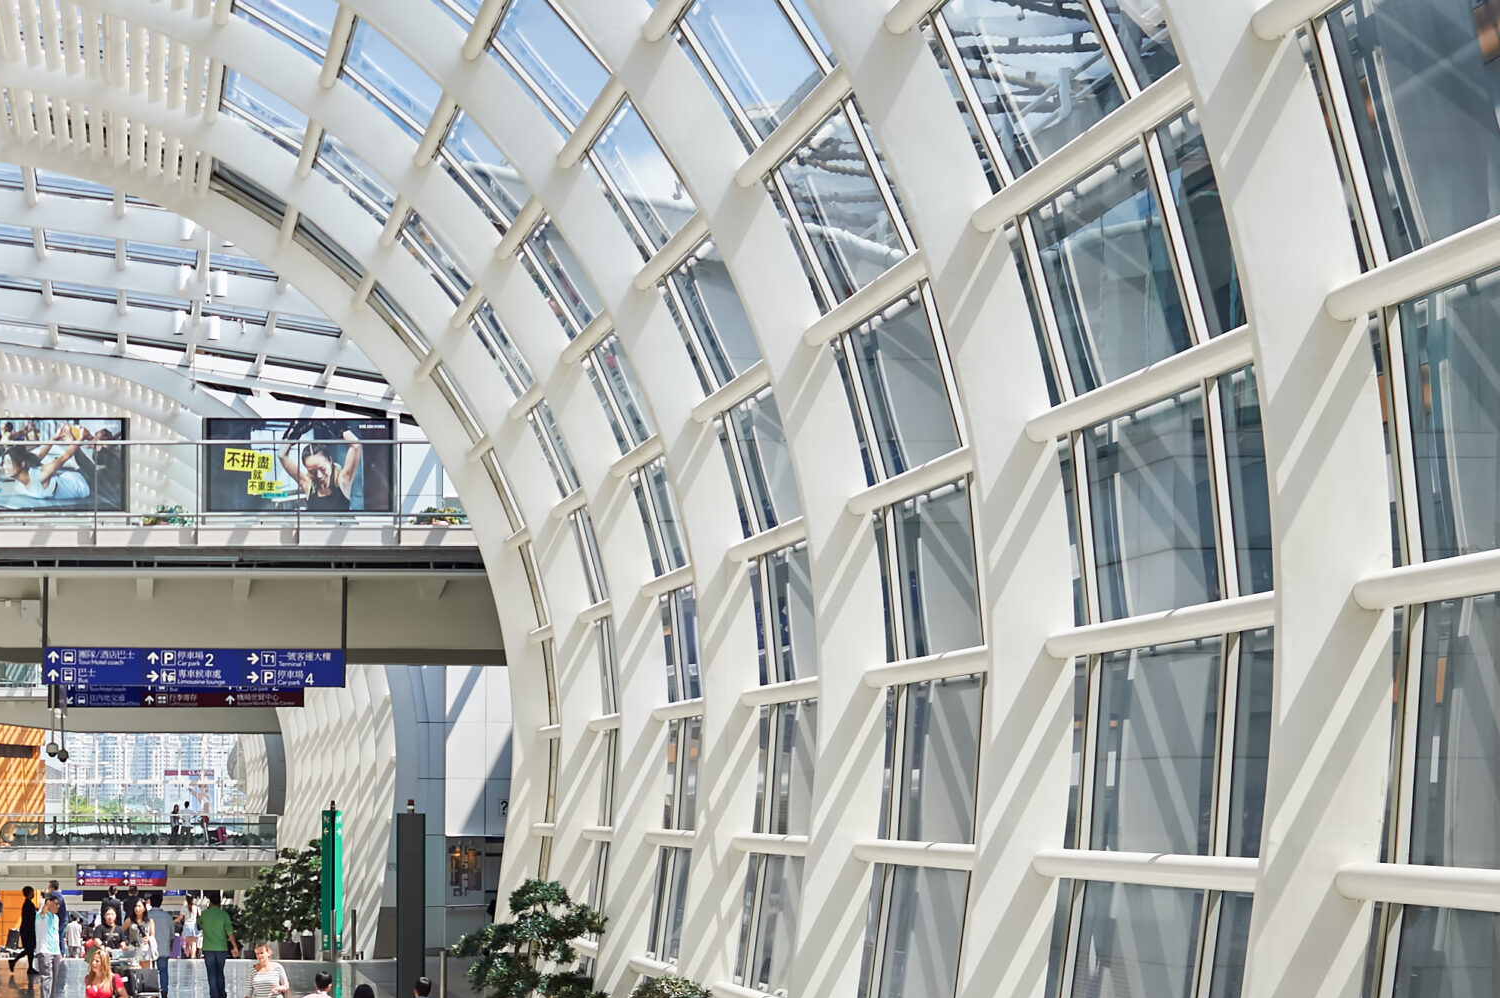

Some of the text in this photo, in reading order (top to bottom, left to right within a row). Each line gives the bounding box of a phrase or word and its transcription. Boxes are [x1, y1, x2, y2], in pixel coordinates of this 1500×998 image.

[227, 451, 269, 469] 不拼盡
[253, 469, 263, 480] 就
[249, 481, 275, 491] 不重生
[177, 651, 204, 660] 停車場
[205, 653, 214, 667] 2
[263, 654, 275, 664] T1
[279, 652, 332, 661] 一號客運大樓
[78, 668, 96, 677] 巴士
[278, 670, 304, 679] 停車場
[305, 673, 314, 686] 4
